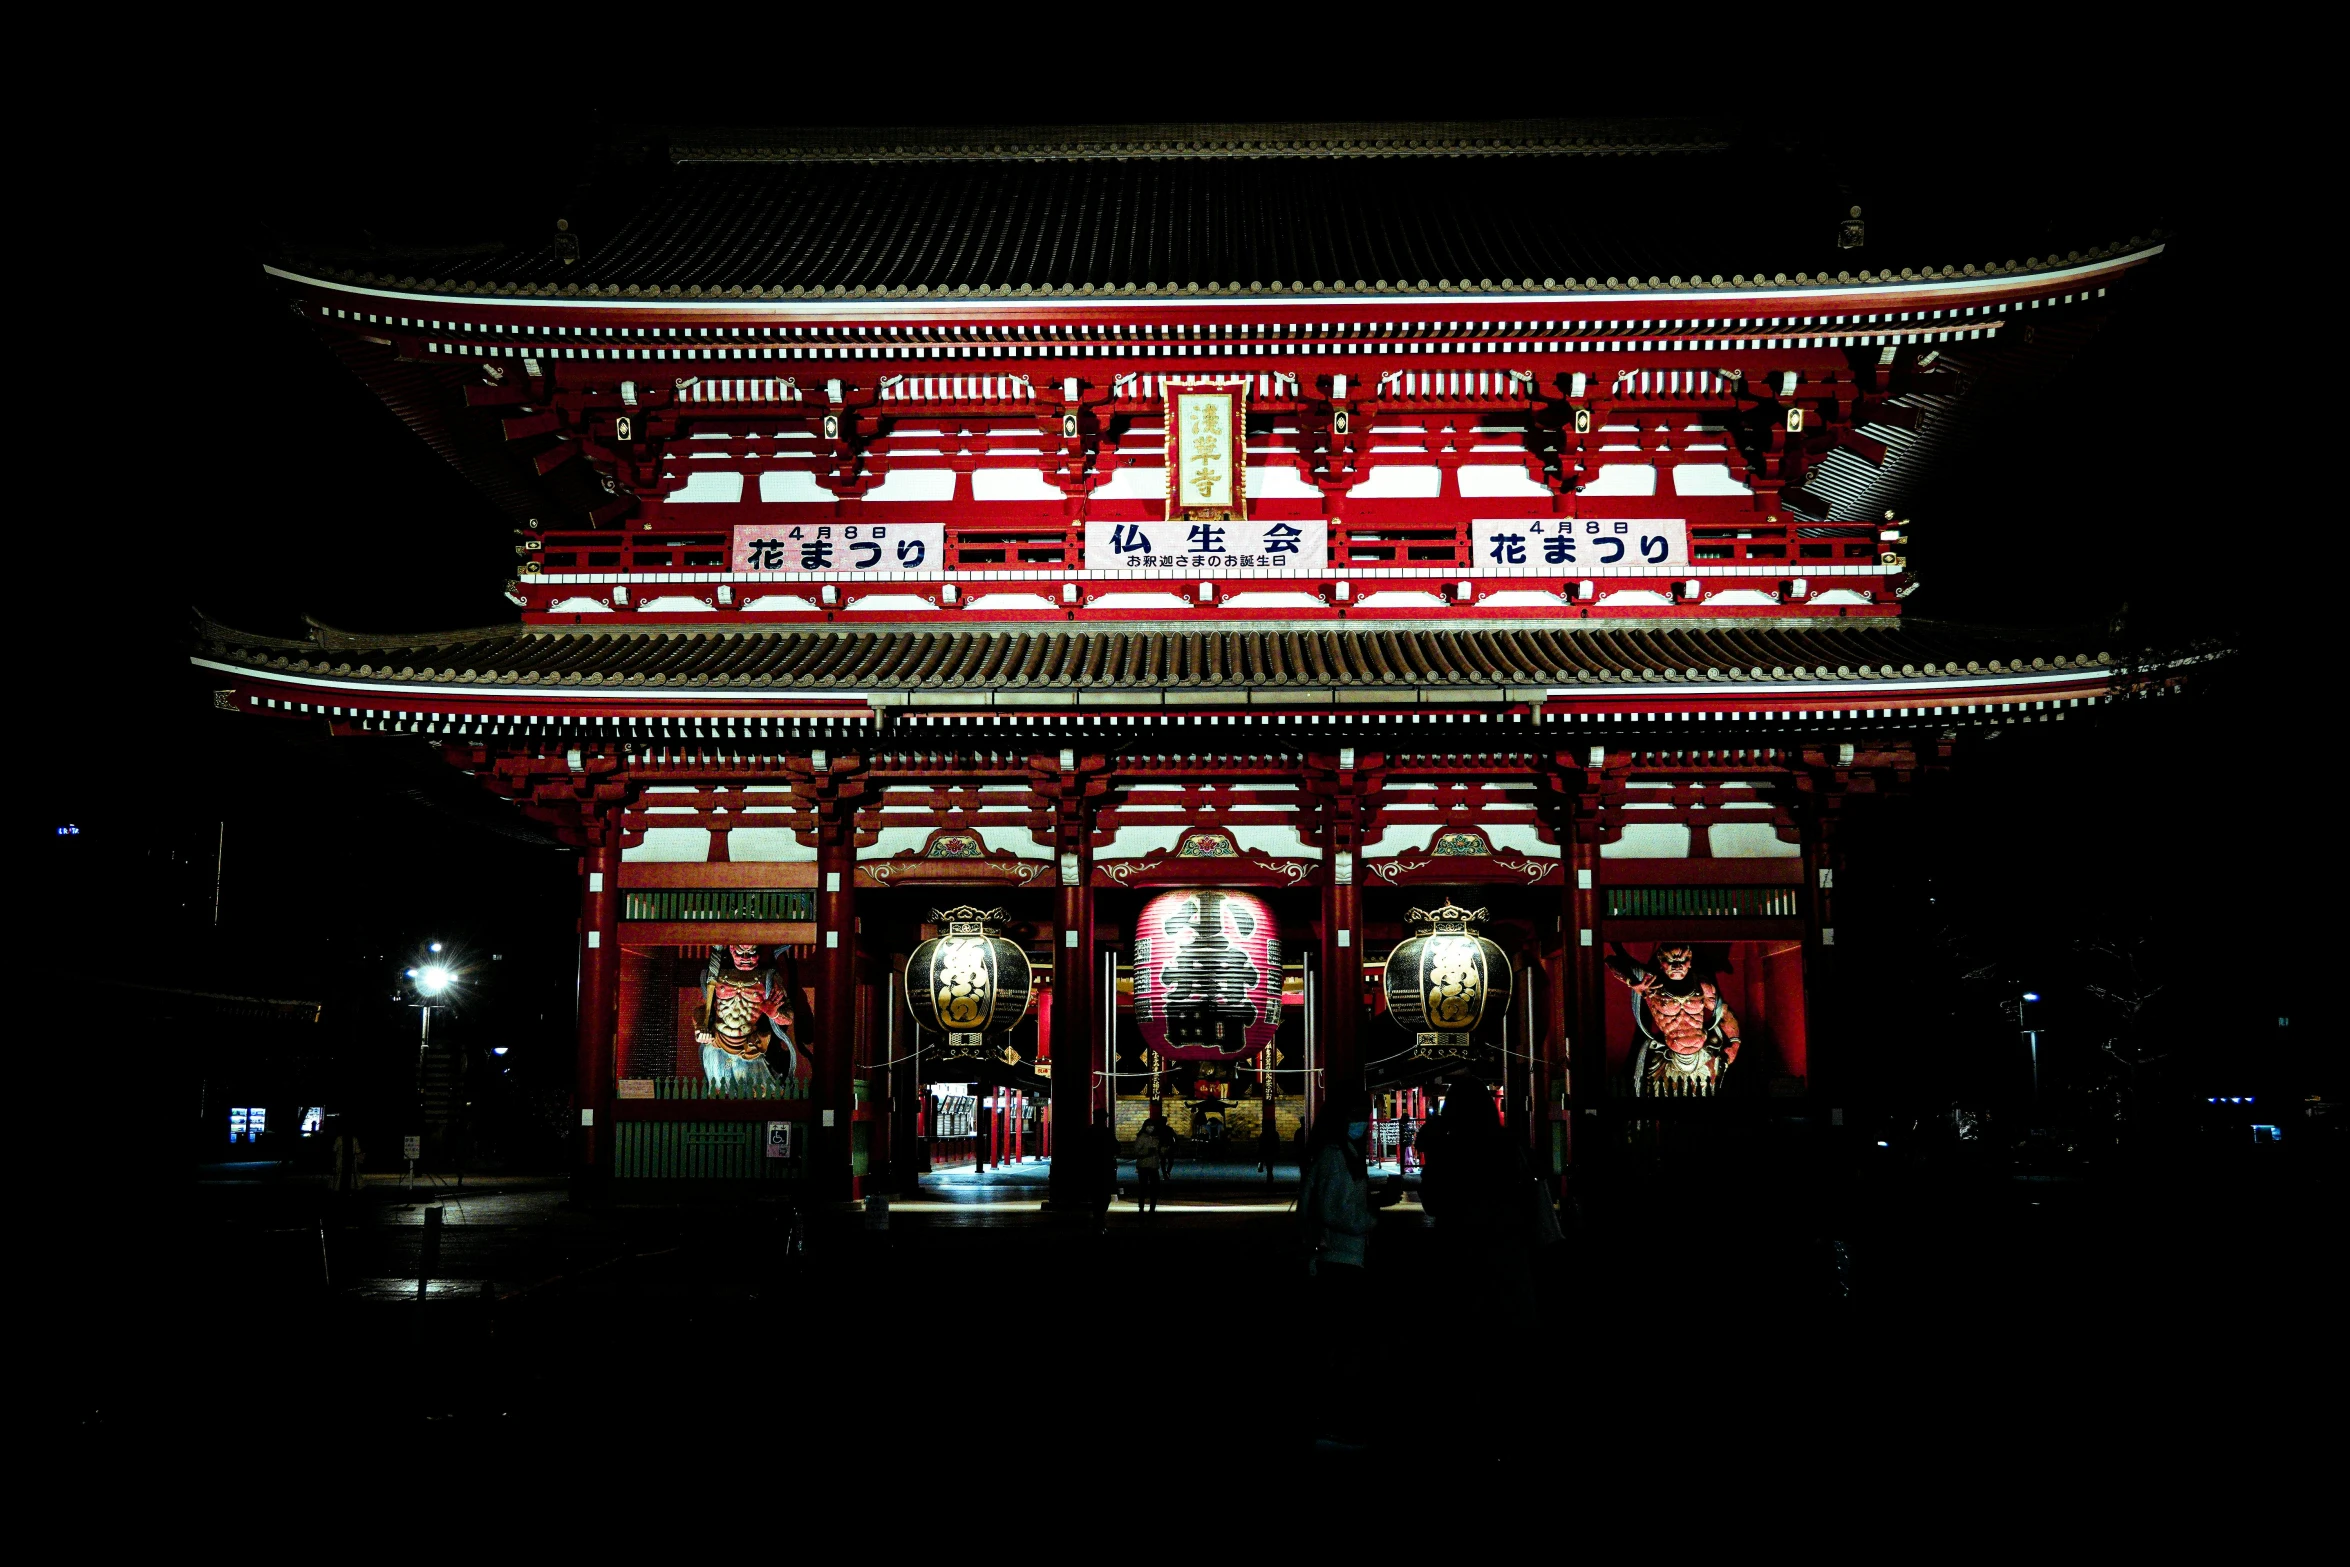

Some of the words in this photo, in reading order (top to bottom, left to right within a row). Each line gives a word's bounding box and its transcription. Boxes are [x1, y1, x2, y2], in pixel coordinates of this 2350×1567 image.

[788, 526, 886, 540] 4月8日
[1108, 523, 1303, 554] 仏生会
[1529, 521, 1628, 534] 4月8日
[747, 538, 925, 569] 花まつり
[1490, 533, 1669, 564] 花まつり
[1126, 555, 1286, 567] お釈迦さまのお誕生日
